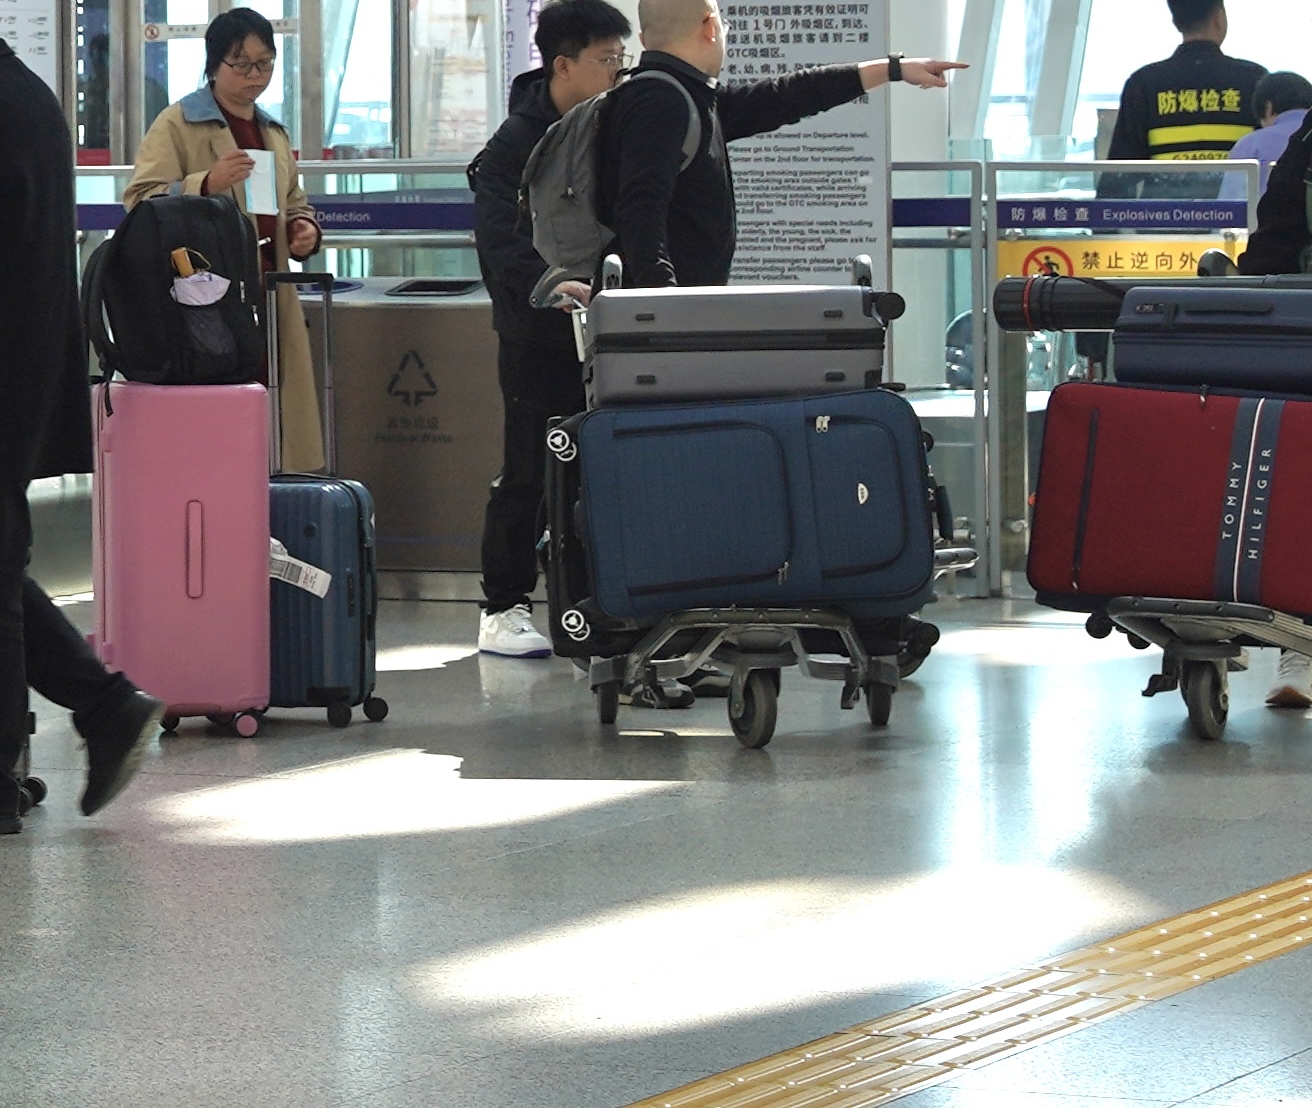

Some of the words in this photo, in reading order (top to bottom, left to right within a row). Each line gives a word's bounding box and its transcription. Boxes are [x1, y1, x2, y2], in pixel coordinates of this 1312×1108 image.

[753, 19, 760, 30] 1
[764, 19, 786, 30] 号门
[727, 47, 786, 59] GTC吸烟区。
[1157, 88, 1241, 115] 防爆检查
[317, 210, 370, 223] Detection
[1011, 207, 1090, 221] 防爆检查
[1103, 208, 1170, 222] Explosives
[1173, 208, 1233, 220] Detection
[1222, 461, 1243, 540] TOMMY
[1247, 447, 1272, 559] HILFIGER
